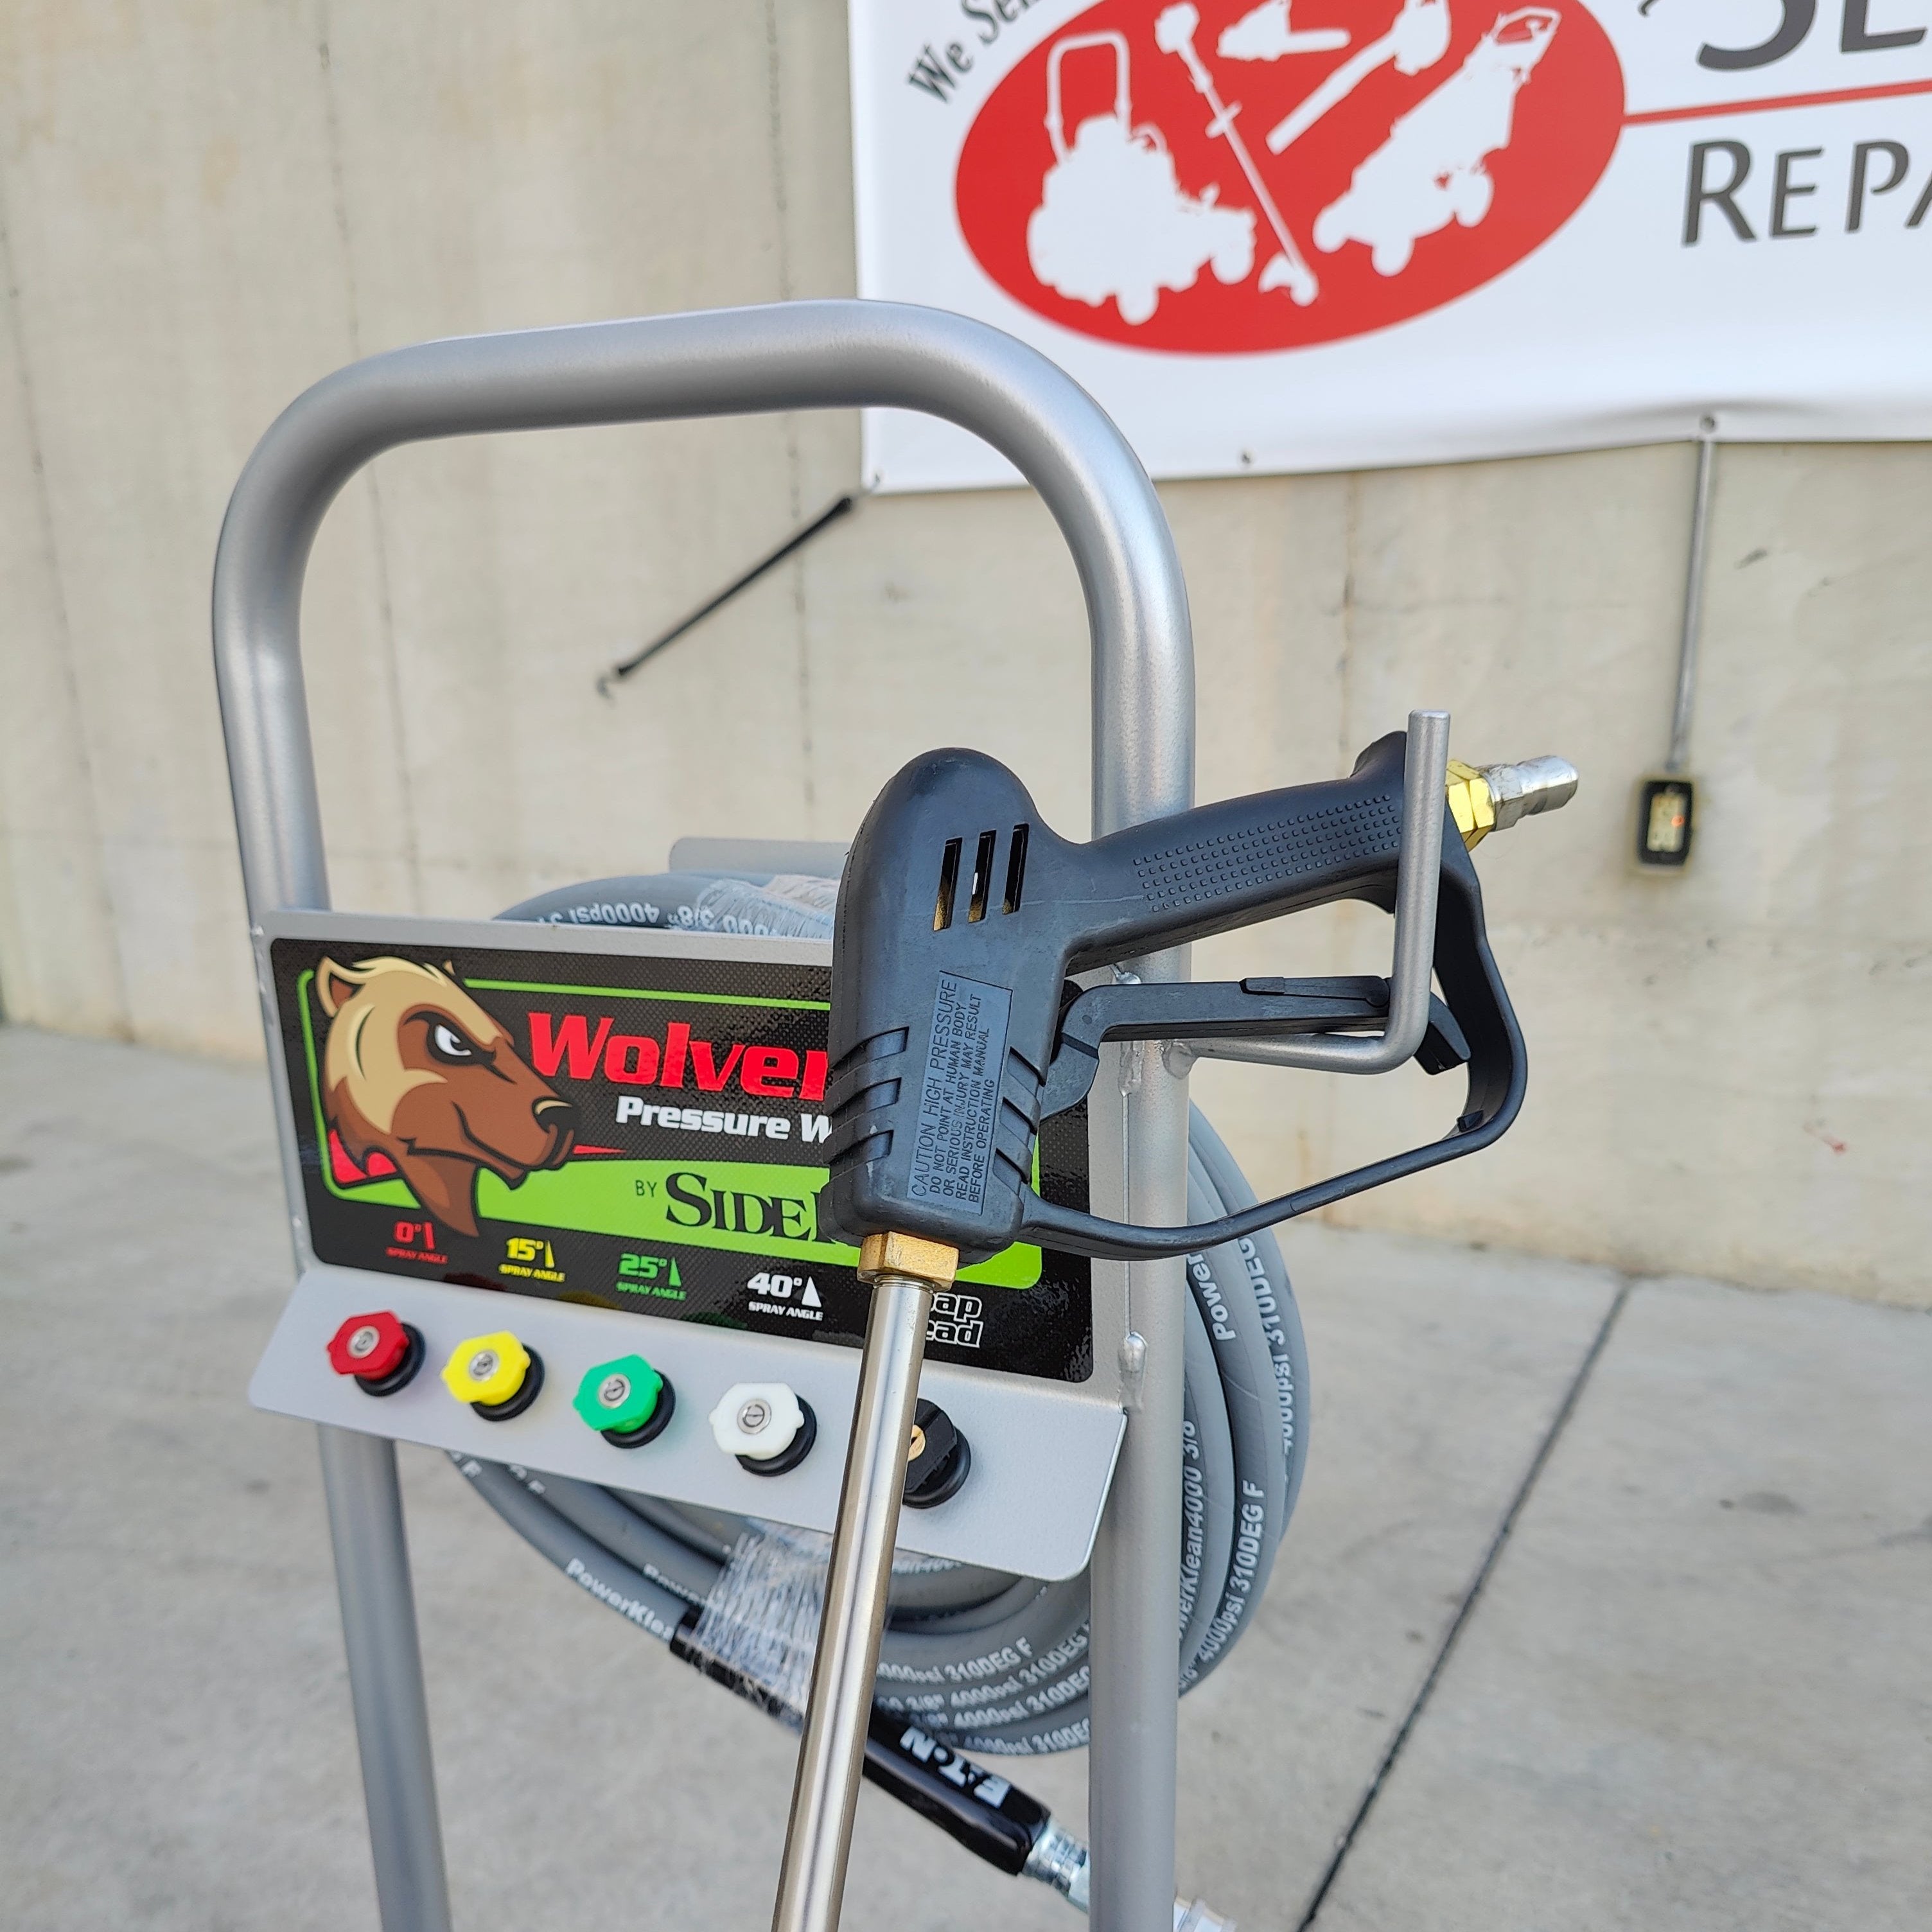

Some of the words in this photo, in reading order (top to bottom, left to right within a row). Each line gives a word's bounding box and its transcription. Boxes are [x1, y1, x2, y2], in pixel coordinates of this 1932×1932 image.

[908, 41, 974, 103] We
[570, 902, 661, 924] 4000psi
[929, 979, 958, 1073] PRESSURE
[953, 1002, 967, 1039] BODY
[965, 994, 982, 1040] RESULT
[945, 1044, 960, 1085] HUMAN
[962, 1043, 975, 1071] MAY
[972, 1028, 990, 1077] MANUAL
[924, 1076, 944, 1117] HIGH
[943, 1087, 954, 1106] AT
[953, 1074, 970, 1117] INJURY
[615, 1094, 791, 1141] Pressure
[936, 1107, 952, 1143] POINT
[960, 1080, 982, 1163] INSTRUCTION
[945, 1121, 962, 1175] SERIOUS
[968, 1148, 985, 1204] BEFORE
[977, 1078, 996, 1150] OPERATING
[910, 1124, 937, 1197] CAUTION
[932, 1148, 945, 1171] NOT
[635, 1179, 658, 1198] BY
[929, 1176, 941, 1194] DO
[942, 1178, 954, 1197] OR
[955, 1170, 969, 1200] READ
[386, 1247, 417, 1260] SPRAY
[417, 1251, 449, 1265] ANGLE
[506, 1236, 544, 1261] 15°
[619, 1252, 668, 1279] 25°
[498, 1263, 533, 1278] SPRAY
[531, 1269, 566, 1283] ANGLE
[615, 1281, 653, 1296] SPRAY
[651, 1287, 687, 1301] ANGLE
[746, 1271, 803, 1299] 40°
[748, 1301, 786, 1316] SPRAY
[784, 1306, 824, 1321] ANGLE
[931, 1292, 983, 1322] ap
[1242, 1479, 1265, 1499] F
[1179, 1464, 1204, 1642] werKlean4000
[1229, 1502, 1265, 1594] 310DEG
[1197, 1592, 1247, 1665] 4000psi
[944, 1646, 1022, 1684] 310DEG
[1015, 1636, 1033, 1658] F
[1019, 1633, 1088, 1686] 310DEG
